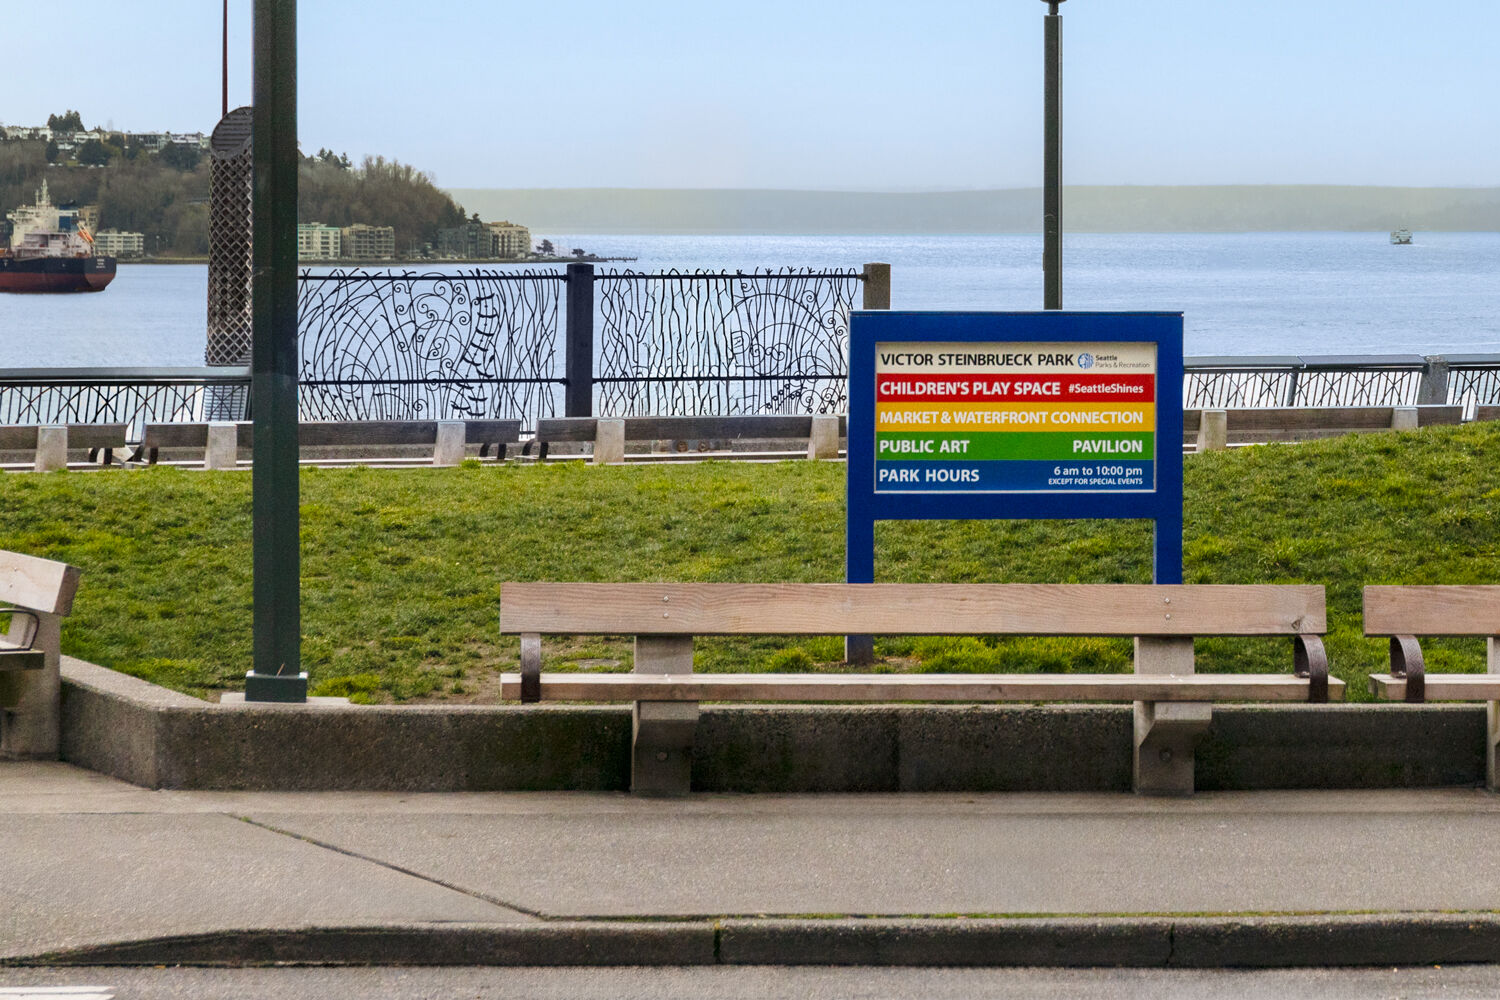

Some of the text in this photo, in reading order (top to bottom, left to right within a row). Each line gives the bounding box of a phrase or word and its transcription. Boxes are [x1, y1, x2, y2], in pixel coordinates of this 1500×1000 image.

[881, 353, 1074, 366] VICTOR STEINBRUECK PARK
[880, 381, 1061, 395] CHILDREN'S PLAY SPACE
[1068, 383, 1144, 394] #SeattleShines
[880, 411, 1143, 424] MARKET & WATERFRONT CONNECTION
[880, 440, 970, 453] PUBLIC ART
[1073, 440, 1143, 453] PAVILION
[879, 469, 980, 482] PARK HOURS
[1053, 466, 1143, 478] 6 am to 10:00 pm
